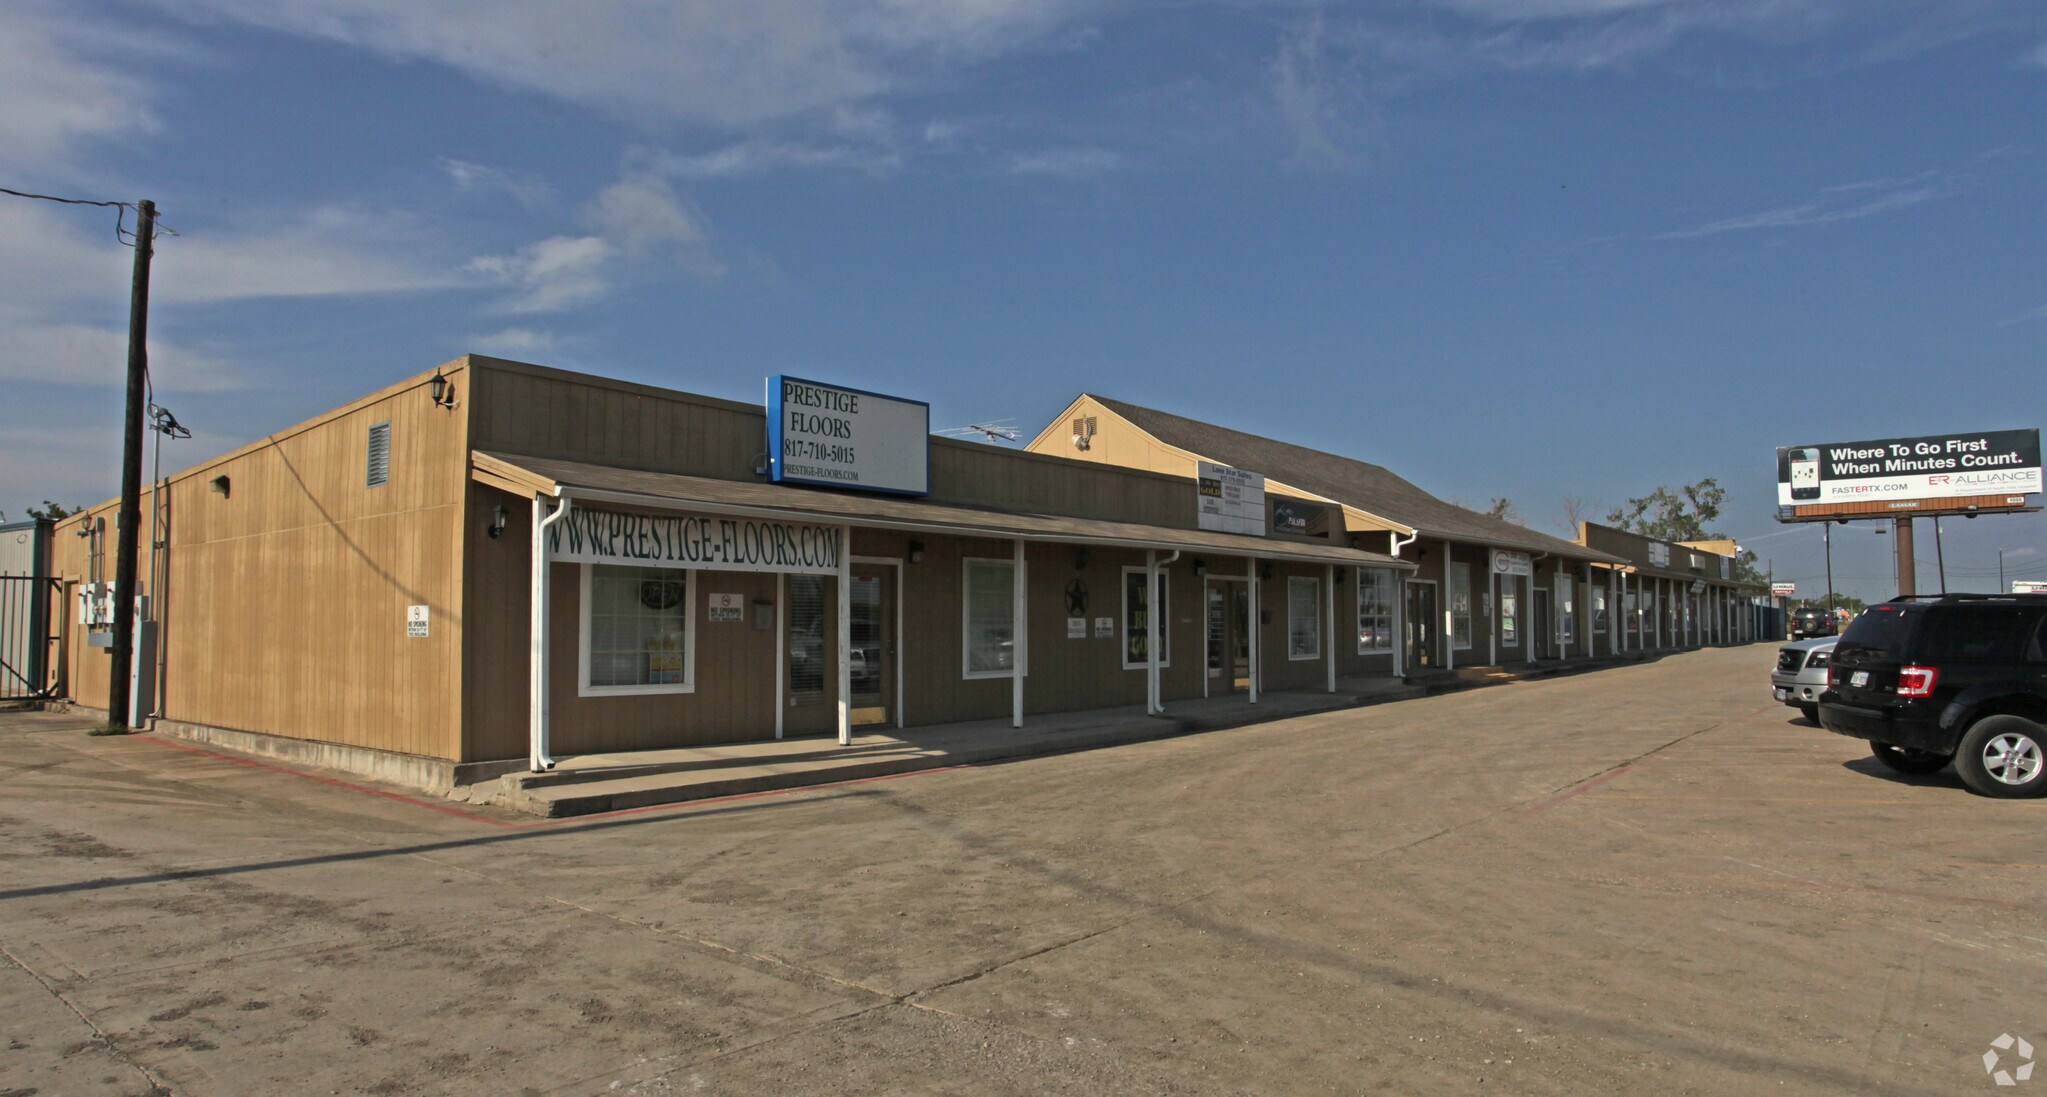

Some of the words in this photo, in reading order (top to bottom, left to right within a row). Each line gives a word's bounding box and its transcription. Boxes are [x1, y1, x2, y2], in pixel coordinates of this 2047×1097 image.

[784, 383, 858, 414] PRESTIGE
[790, 411, 851, 439] FLOORS
[784, 438, 855, 464] 817-710-5015
[1830, 447, 1885, 461] Where
[1889, 444, 1910, 457] To
[1915, 442, 1941, 455] Go
[1946, 438, 1987, 453] First
[783, 463, 859, 481] PRESTIGE-FLOORS.COM
[1832, 462, 1880, 475] When
[1885, 456, 1956, 472] Minutes
[1961, 451, 2023, 467] Count.
[1237, 471, 1253, 480] Suites
[1928, 475, 1950, 485] ER
[1955, 470, 2037, 484] ALLIANCE
[1201, 487, 1220, 495] GOLD
[1832, 483, 1908, 494] FASTERTX.COM
[546, 504, 838, 568] WWW.PRESTIGE-FLOORS.COM
